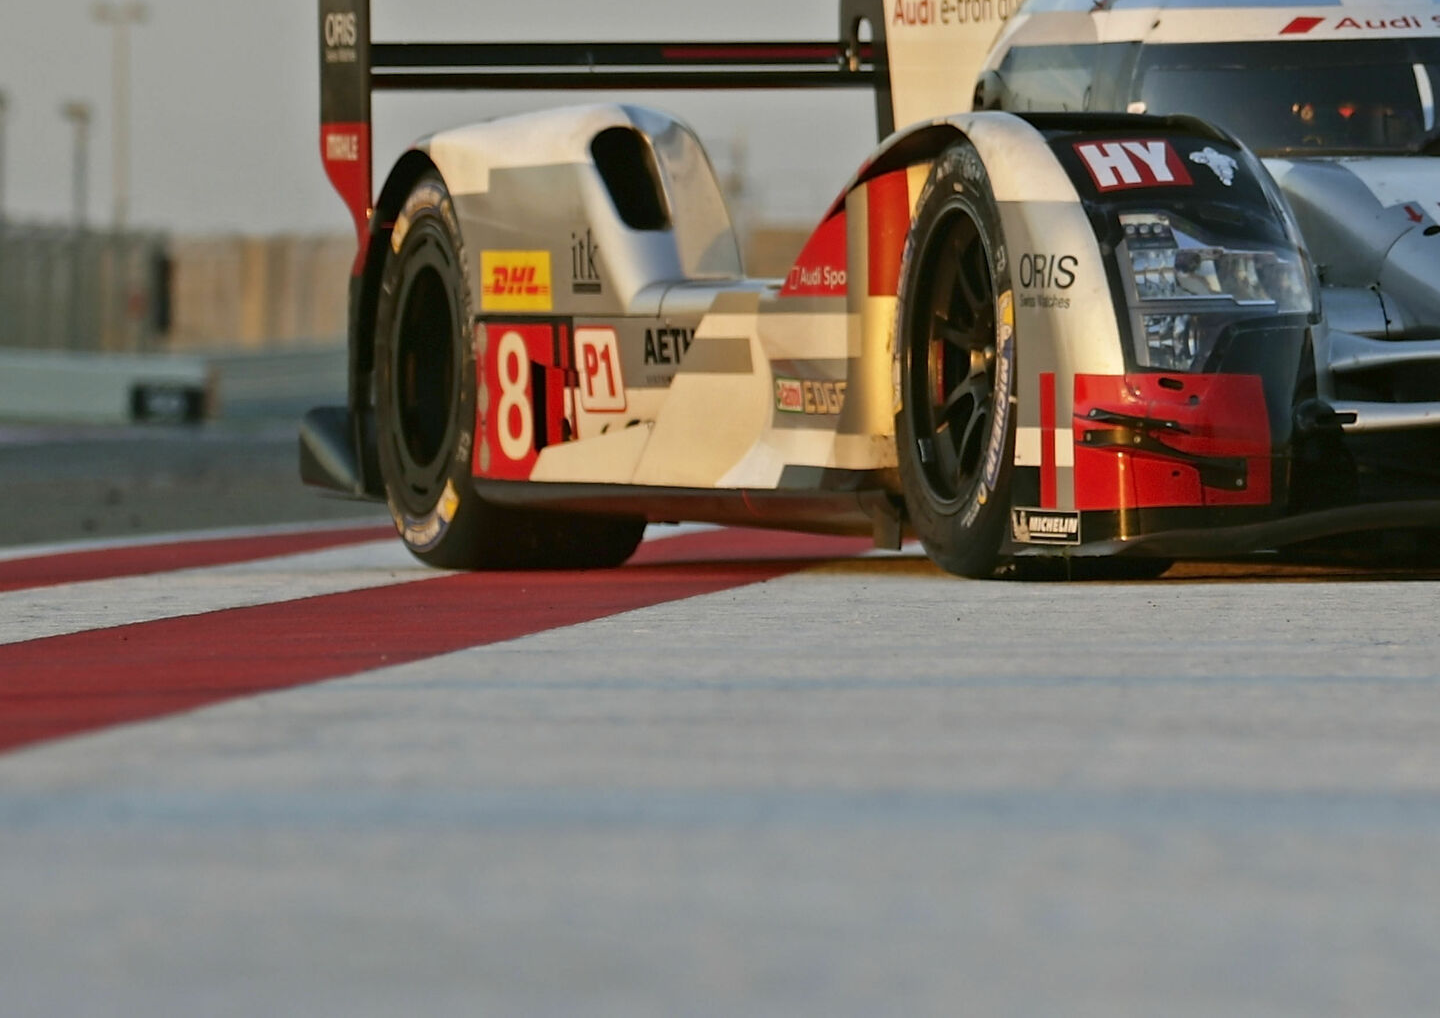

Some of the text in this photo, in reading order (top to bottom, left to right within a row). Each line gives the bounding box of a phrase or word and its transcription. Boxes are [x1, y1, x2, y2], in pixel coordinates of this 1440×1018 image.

[325, 13, 357, 46] ORIS
[1335, 15, 1422, 30] Audi
[1079, 142, 1174, 187] HY
[571, 228, 604, 280] itk
[1020, 253, 1078, 289] ORIS
[492, 266, 540, 294] DHL
[800, 267, 821, 285] Audi
[583, 344, 616, 398] P1
[498, 331, 534, 460] 8
[1030, 516, 1078, 533] MICHELIN
